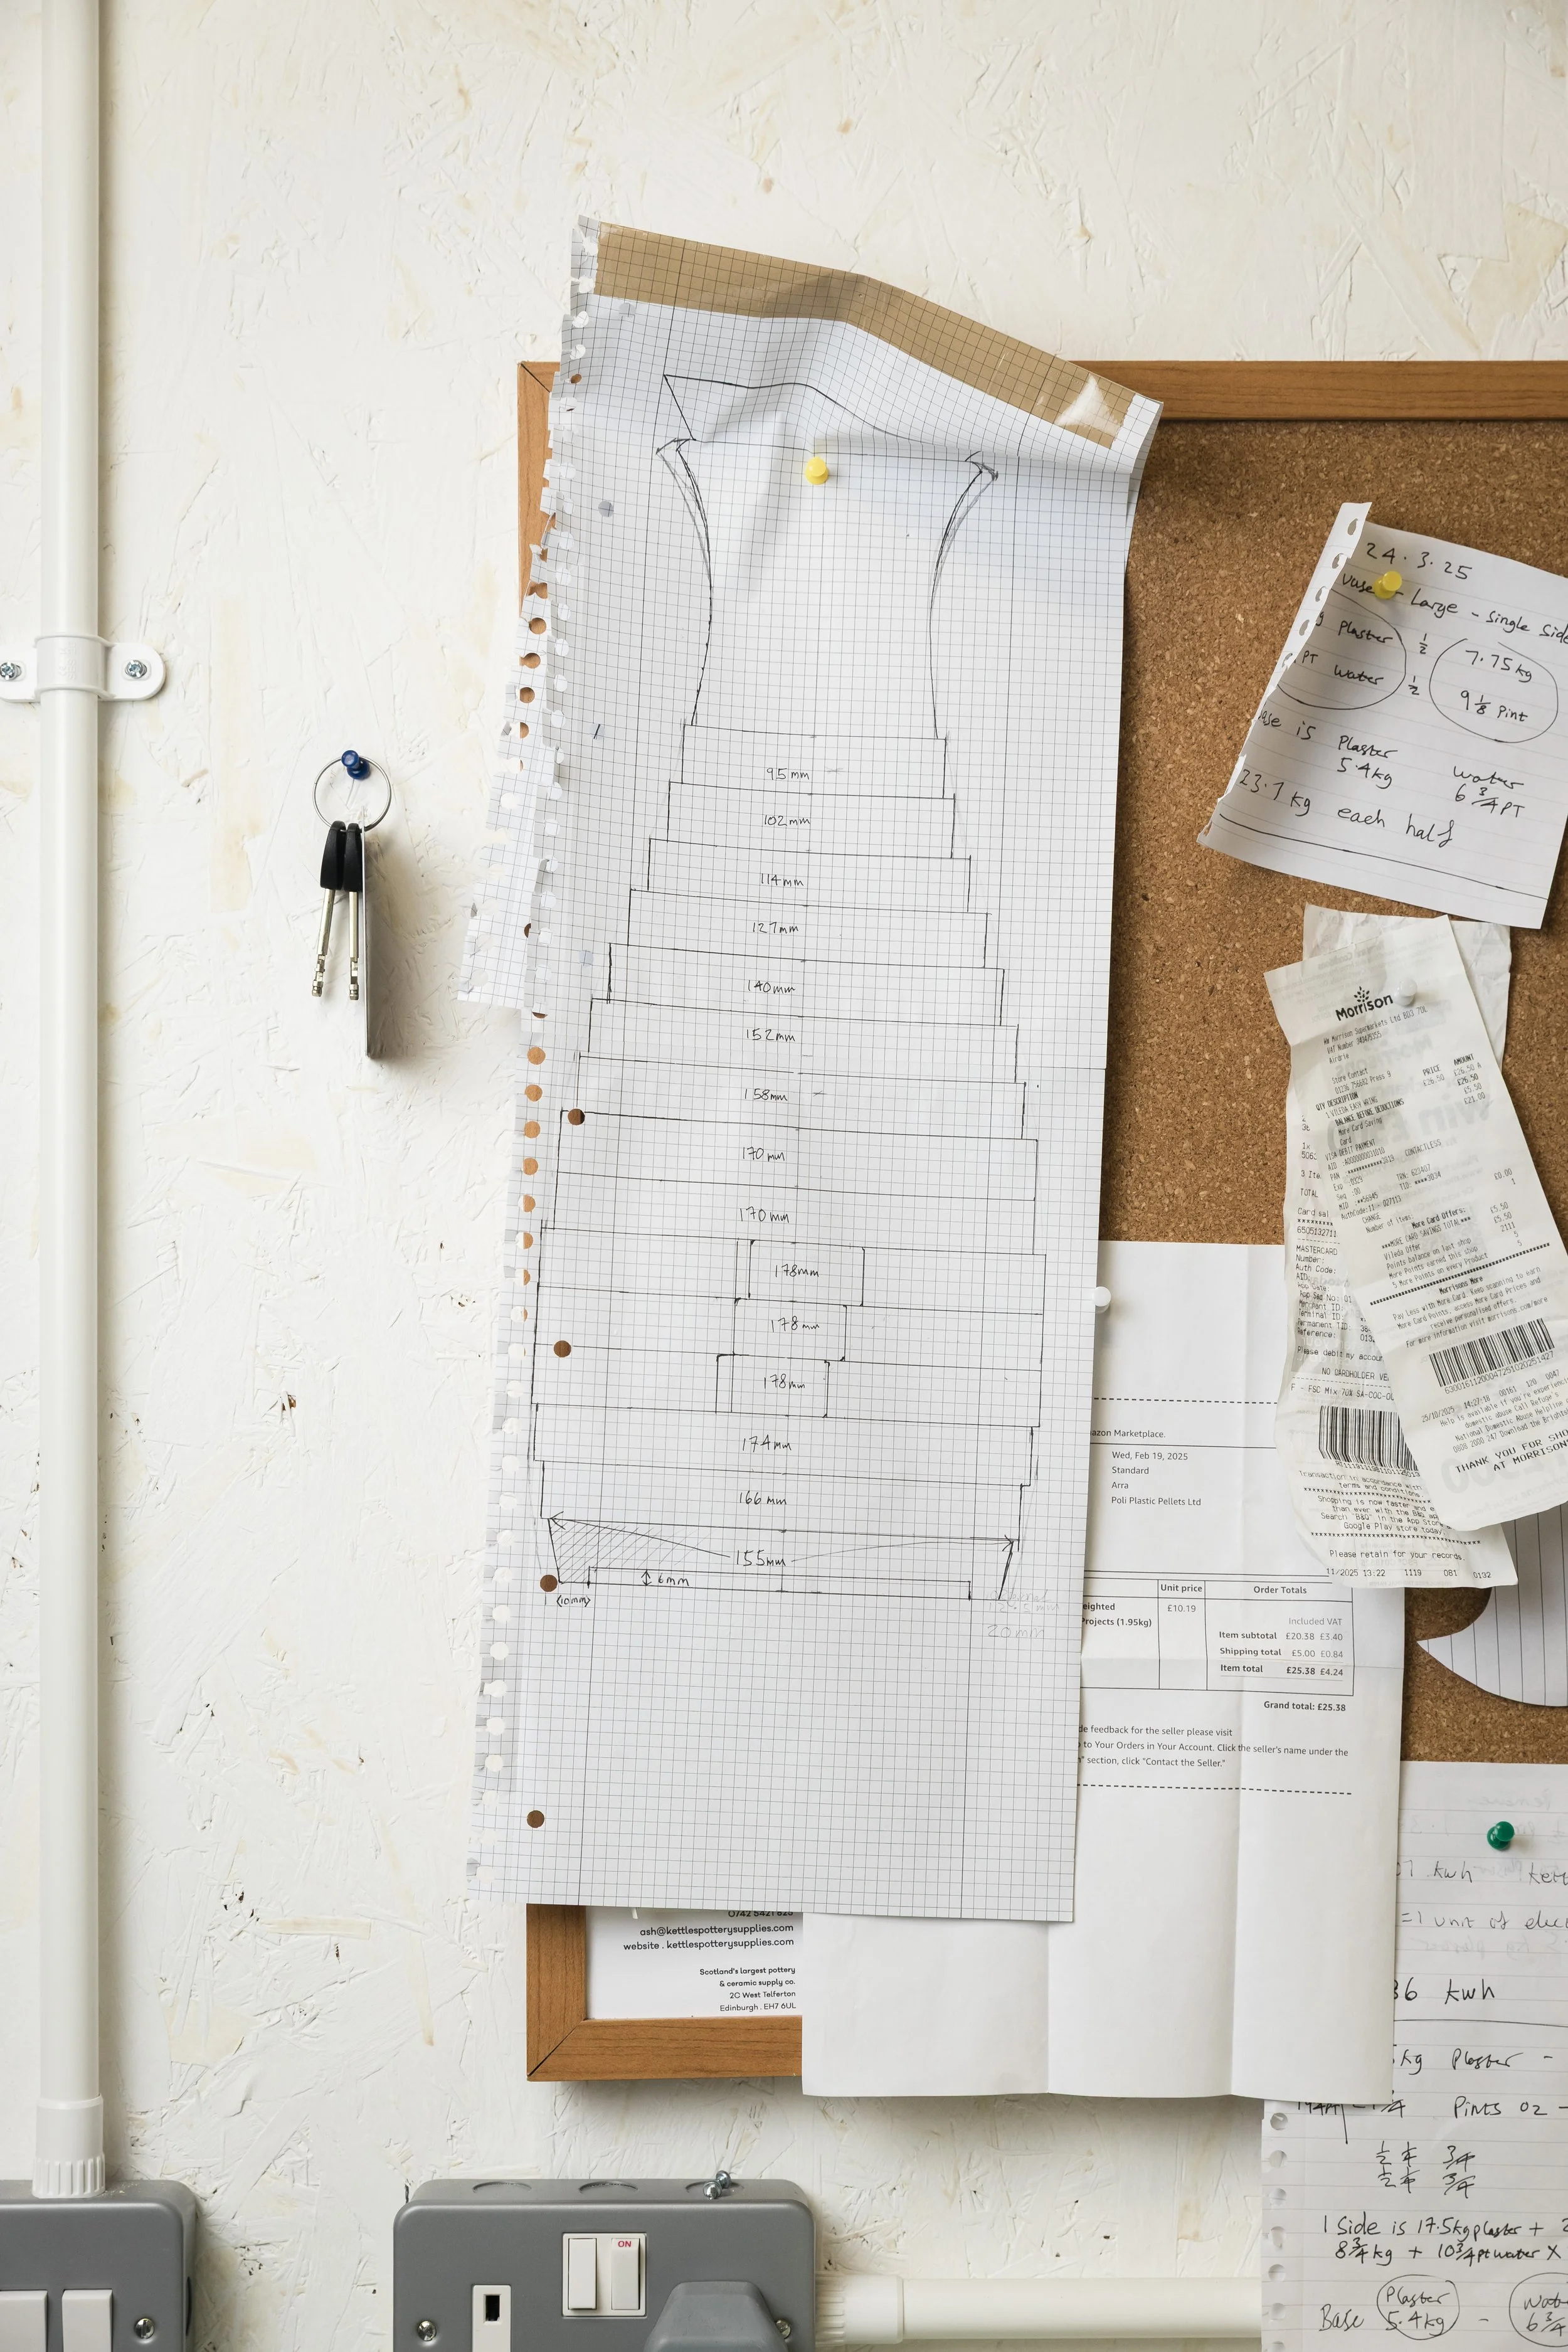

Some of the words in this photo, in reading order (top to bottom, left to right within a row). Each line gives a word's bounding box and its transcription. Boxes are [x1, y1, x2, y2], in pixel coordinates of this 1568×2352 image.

[1338, 807, 1385, 827] each
[1406, 813, 1454, 847] half
[1336, 994, 1393, 1021] Morrison
[1423, 1065, 1441, 1076] PRICE
[1454, 1054, 1474, 1066] AMOUNT
[1458, 1073, 1478, 1086] £26.50
[1464, 1093, 1485, 1104] £21.00
[1405, 1139, 1441, 1157] CONTACTLESS
[1300, 1189, 1318, 1197] TOTAL
[1296, 1245, 1338, 1256] MASTERCARD
[1296, 1264, 1312, 1272] Auth
[1316, 1264, 1336, 1274] Code:
[1422, 1406, 1454, 1422] 25/10/2025
[1464, 1395, 1490, 1409] 14:27:18
[1455, 1428, 1483, 1441] National
[1486, 1418, 1513, 1431] Domestic
[1516, 1411, 1533, 1421] Abuse
[1535, 1401, 1563, 1414] Helpline
[1115, 1430, 1165, 1438] Marketplace.
[1112, 1451, 1132, 1460] Wed,
[1153, 1453, 1164, 1461] 19,
[1455, 1456, 1489, 1473] THANK
[1495, 1447, 1516, 1459] YOU
[1522, 1439, 1542, 1450] FOR
[1494, 1461, 1506, 1471] AT
[1318, 1495, 1352, 1506] Shopping
[1386, 1500, 1410, 1508] faster
[1344, 1522, 1370, 1531] Google
[1375, 1522, 1392, 1531] Play
[1411, 1551, 1427, 1559] your
[1432, 1552, 1465, 1560] records.
[1182, 1584, 1202, 1593] price
[1083, 1603, 1115, 1611] eighted
[1117, 1618, 1152, 1627] (1.95kg)
[1220, 1648, 1258, 1656] Shipping
[1292, 1702, 1315, 1710] total:
[1091, 1725, 1128, 1734] feedback
[1187, 1728, 1213, 1737] please
[1217, 1744, 1236, 1752] Click
[1088, 1757, 1119, 1765] section,
[1197, 1759, 1226, 1767] Seller."
[640, 1924, 793, 1936] ash@kettlespotterysupplies.com
[623, 1942, 659, 1951] website
[667, 1938, 794, 1950] kettlespotterysupplies.com
[740, 1967, 766, 1975] largest
[720, 2004, 758, 2012] Edinburgh
[1392, 2222, 1406, 2235] is
[1320, 2304, 1364, 2331] Base
